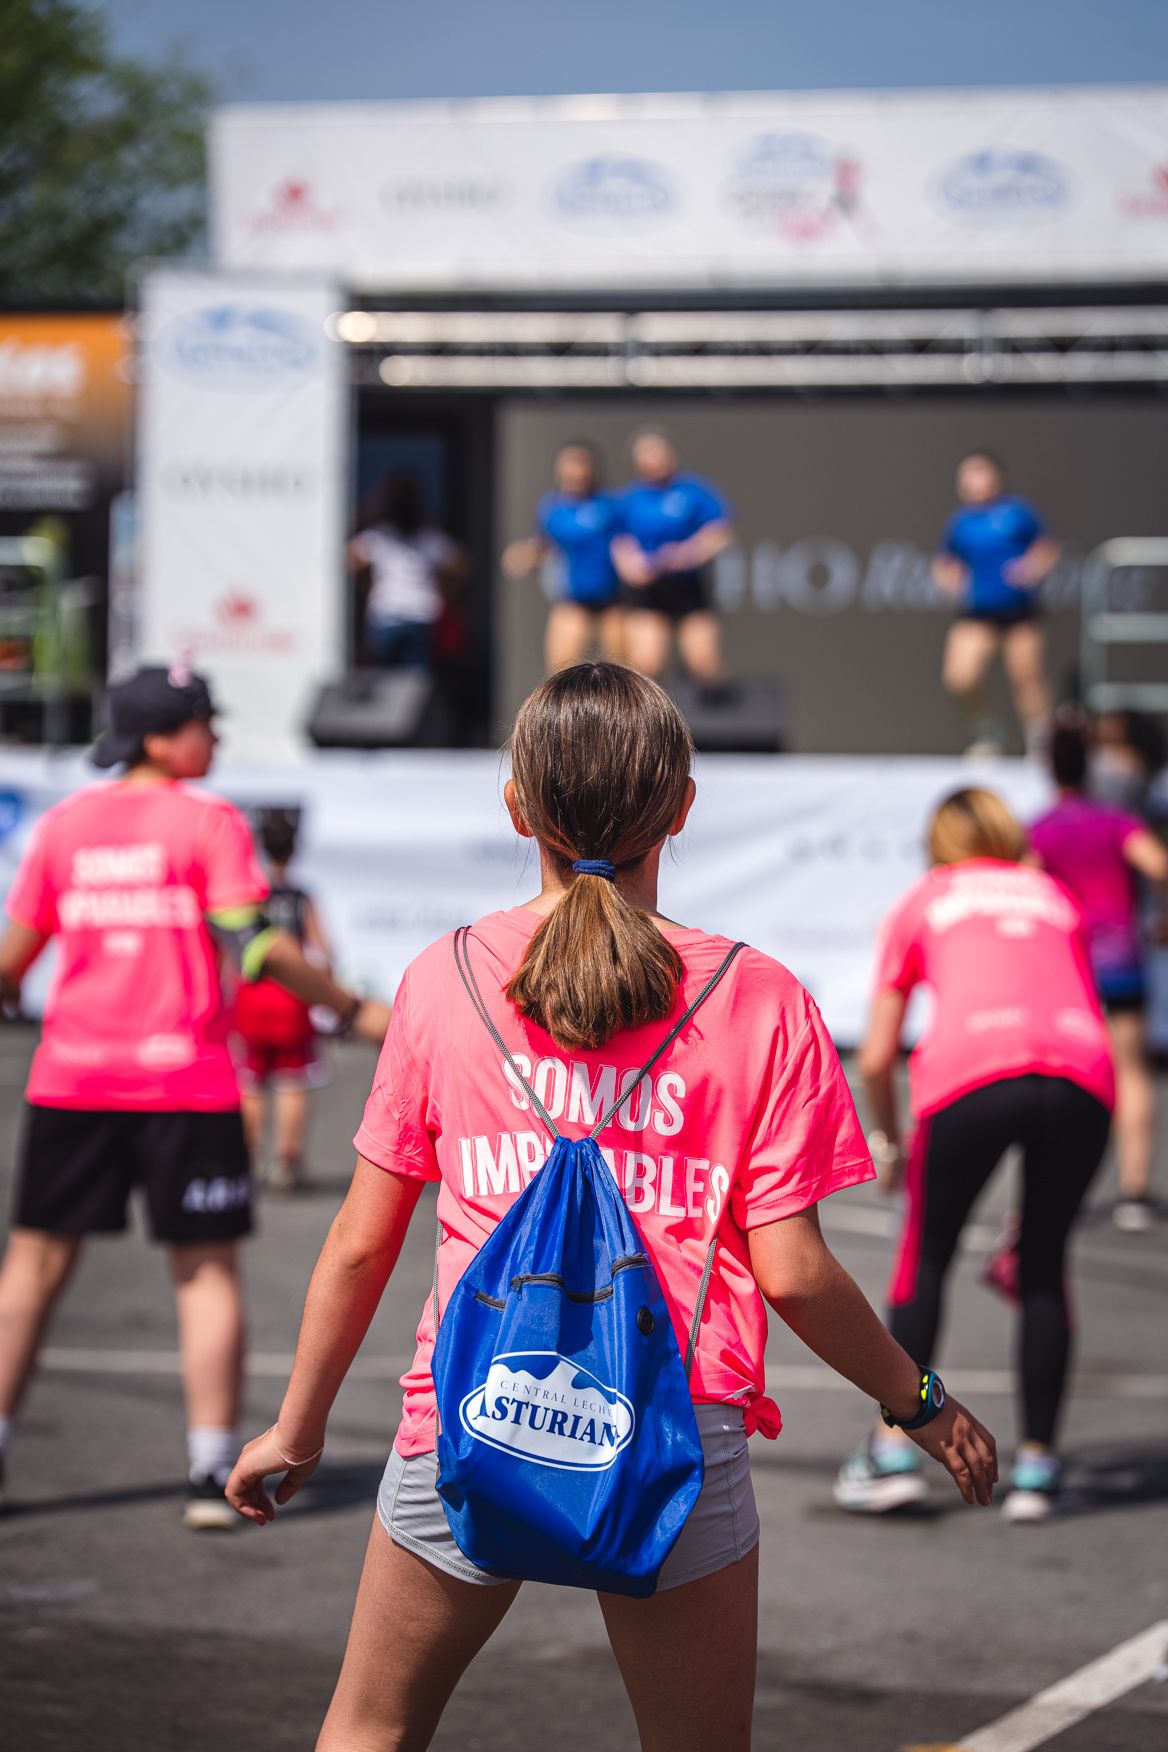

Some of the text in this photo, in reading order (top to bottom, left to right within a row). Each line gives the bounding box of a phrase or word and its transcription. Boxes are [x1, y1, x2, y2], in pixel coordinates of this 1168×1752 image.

[502, 1052, 686, 1136] SOMOS
[472, 1386, 621, 1448] ASTURIAN
[500, 1379, 567, 1405] CENTRAL
